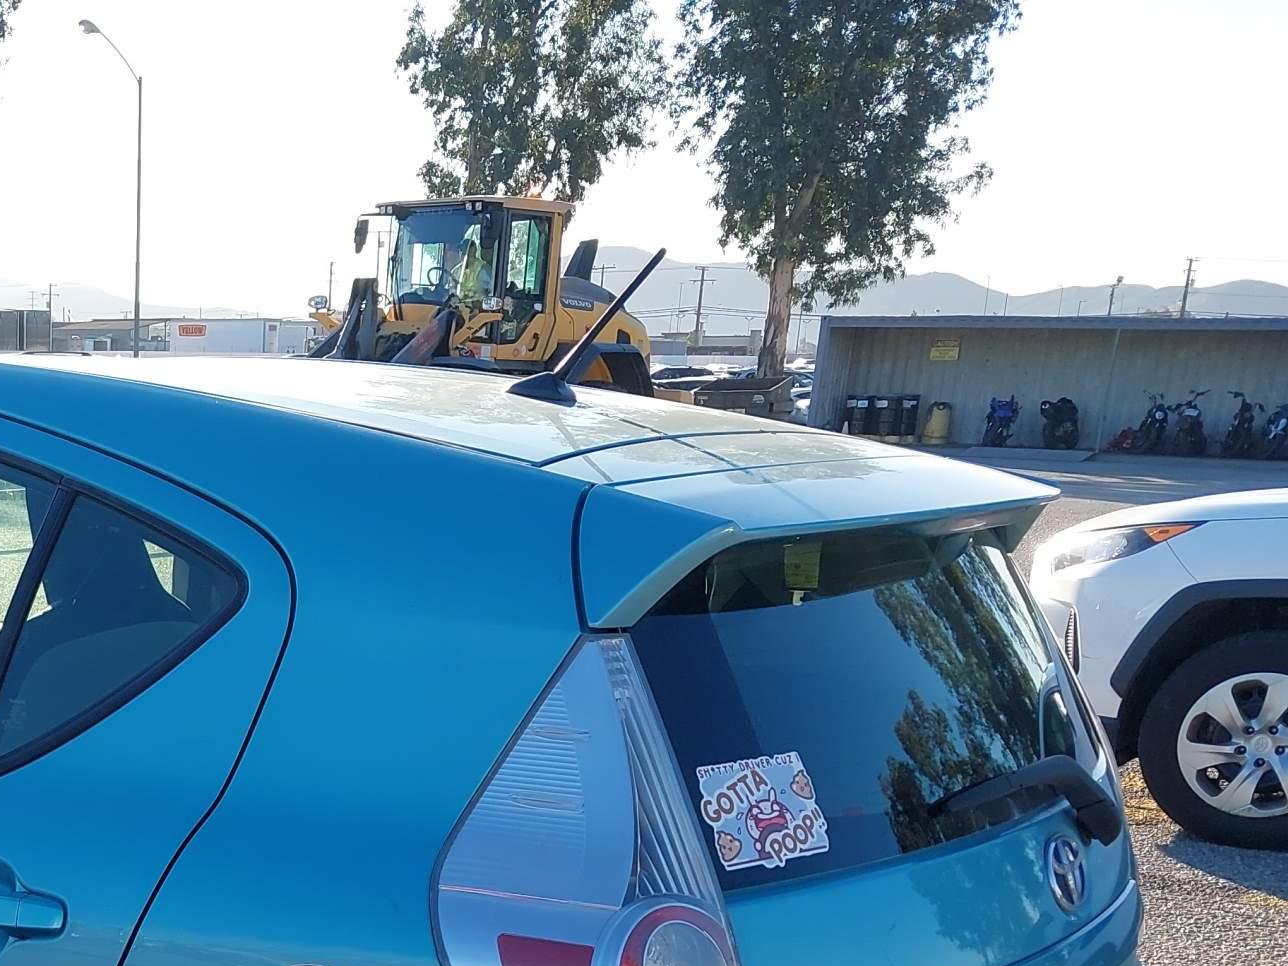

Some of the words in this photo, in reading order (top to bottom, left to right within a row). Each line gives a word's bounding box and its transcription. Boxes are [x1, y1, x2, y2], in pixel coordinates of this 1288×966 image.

[562, 298, 592, 308] VOLVO
[739, 758, 773, 772] DRIVER
[775, 754, 794, 765] CUZ
[703, 769, 769, 823] GOTTA
